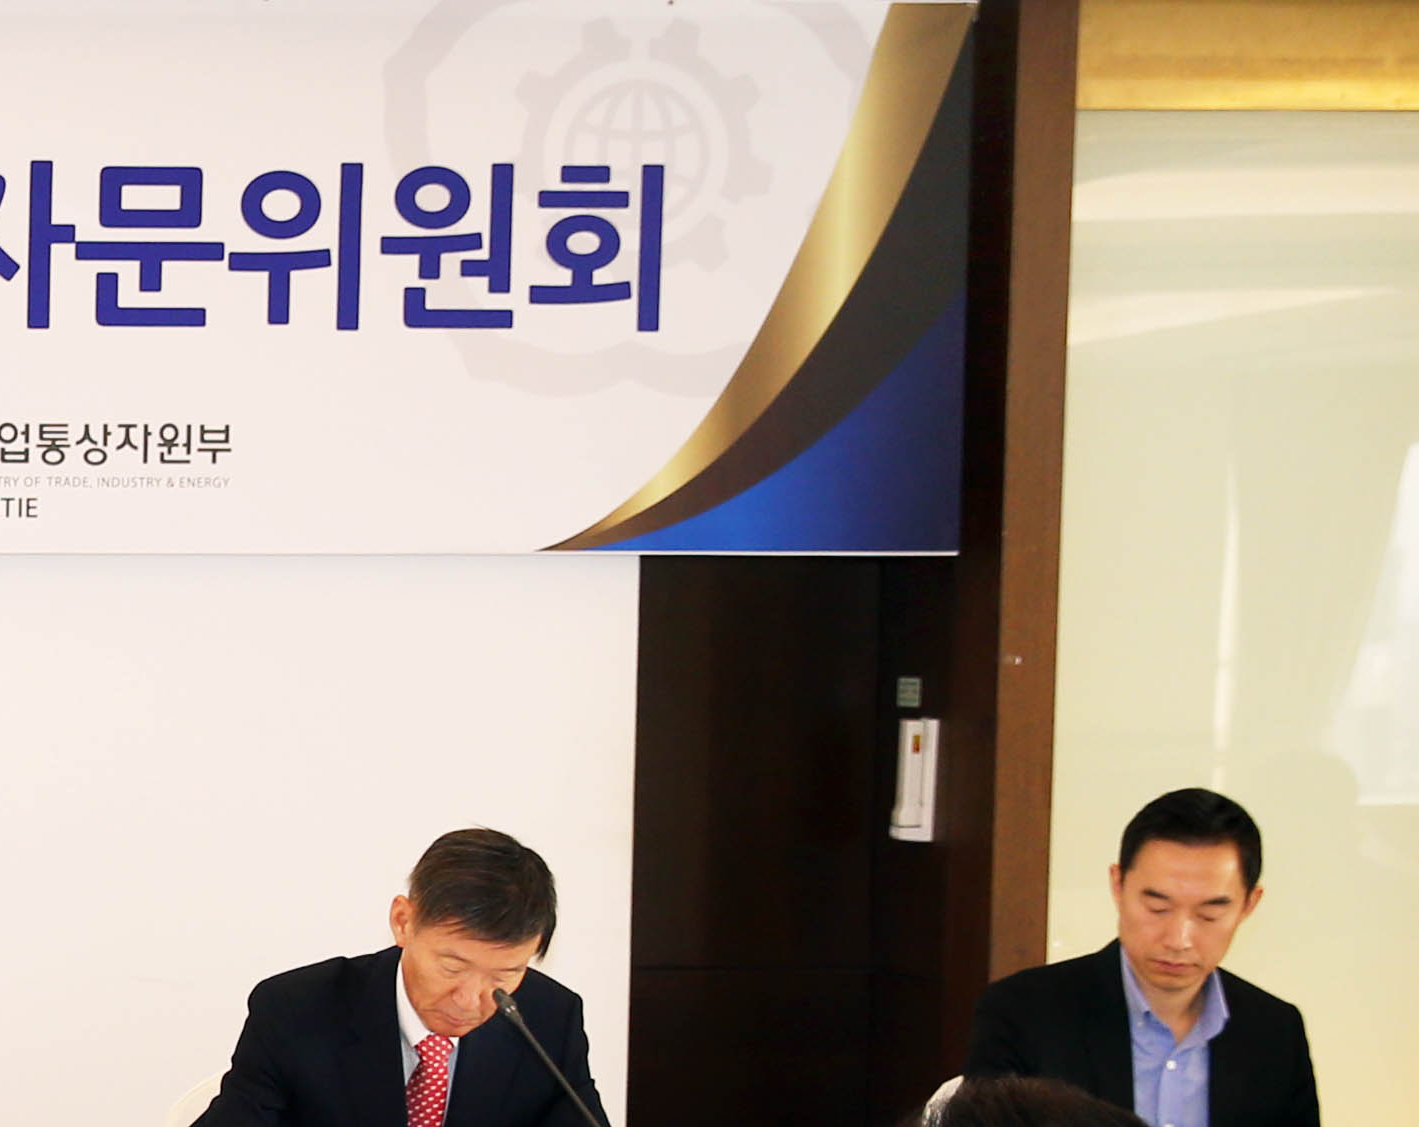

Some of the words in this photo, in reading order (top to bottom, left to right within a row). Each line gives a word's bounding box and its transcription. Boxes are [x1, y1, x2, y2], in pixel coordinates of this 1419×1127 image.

[24, 476, 41, 487] OF
[47, 476, 92, 488] TRADE,
[97, 477, 162, 488] INDUSTRY
[166, 477, 174, 488] &
[179, 477, 230, 488] ENERGY
